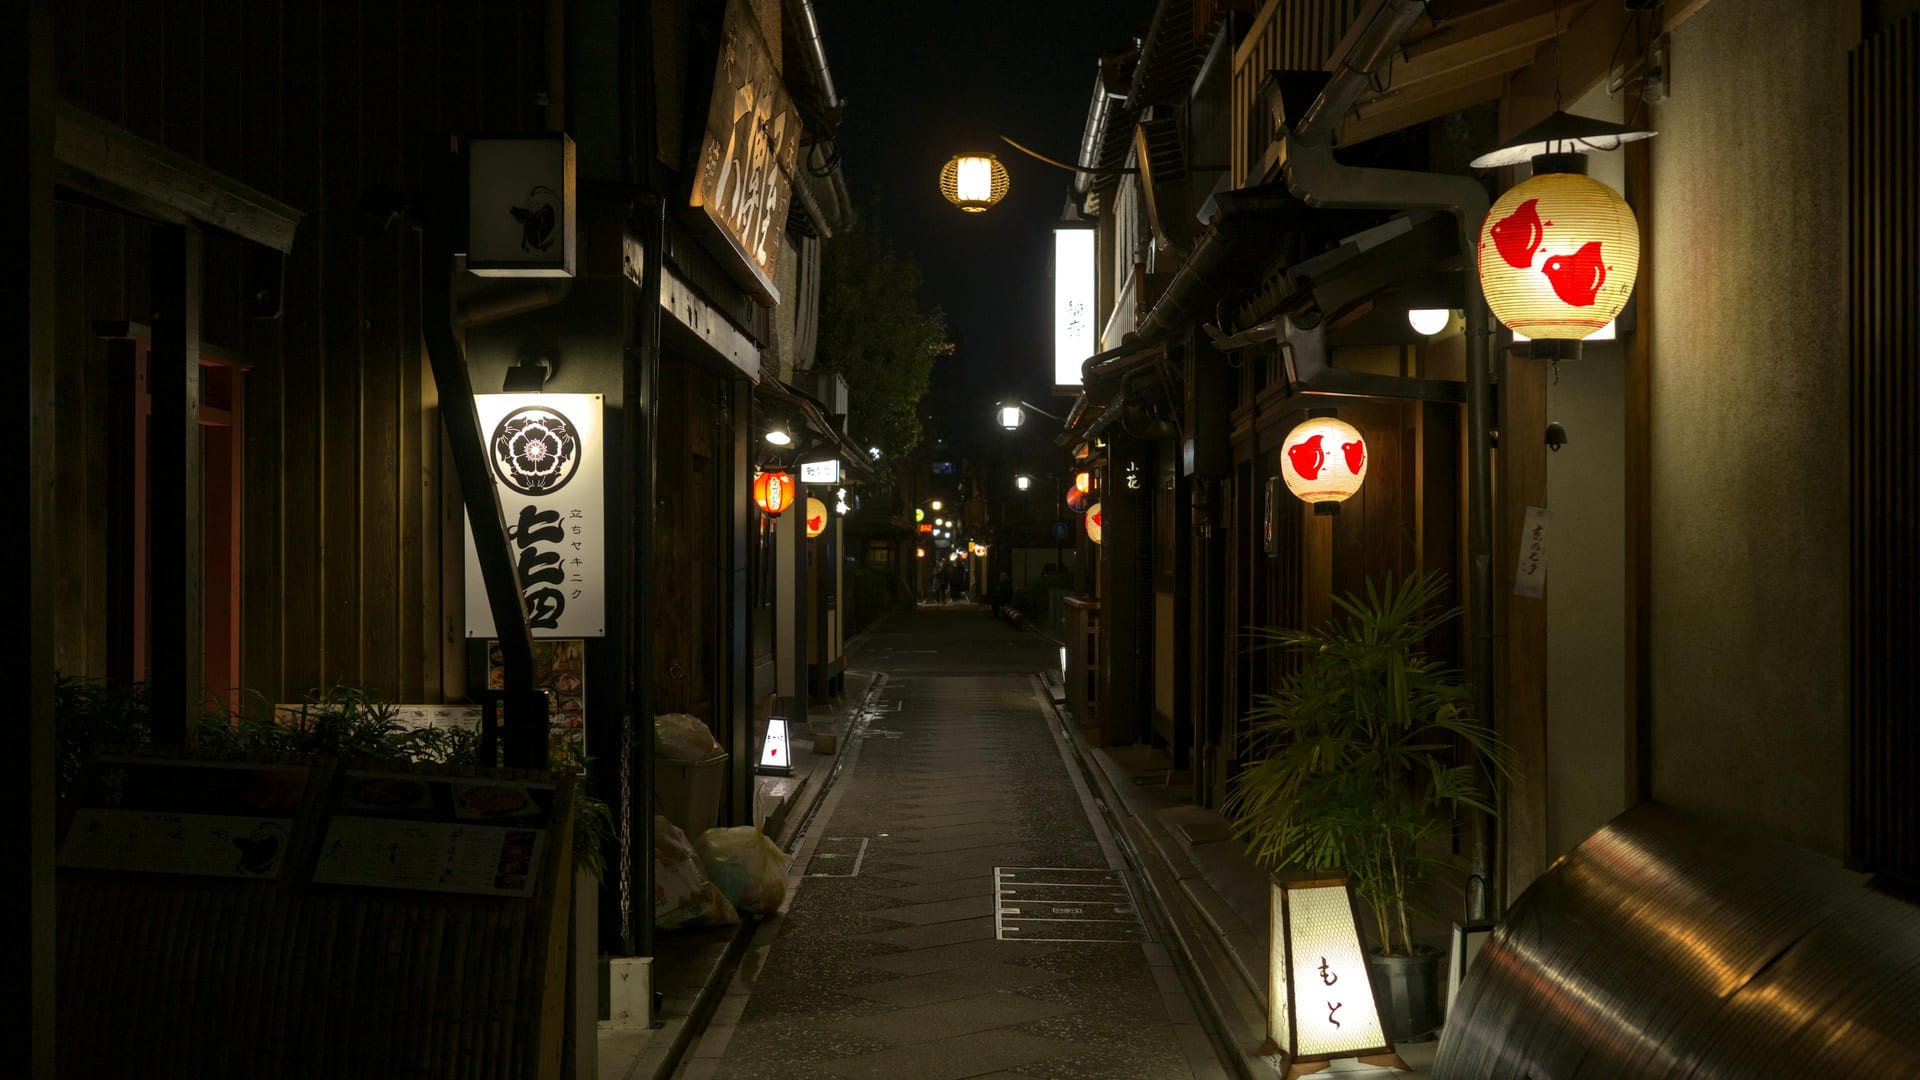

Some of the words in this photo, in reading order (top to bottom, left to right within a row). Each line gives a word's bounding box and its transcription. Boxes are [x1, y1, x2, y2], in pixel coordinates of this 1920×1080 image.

[1126, 461, 1141, 489] 小花
[569, 508, 583, 600] 立ちヤキニク
[1317, 956, 1343, 1029] もと
